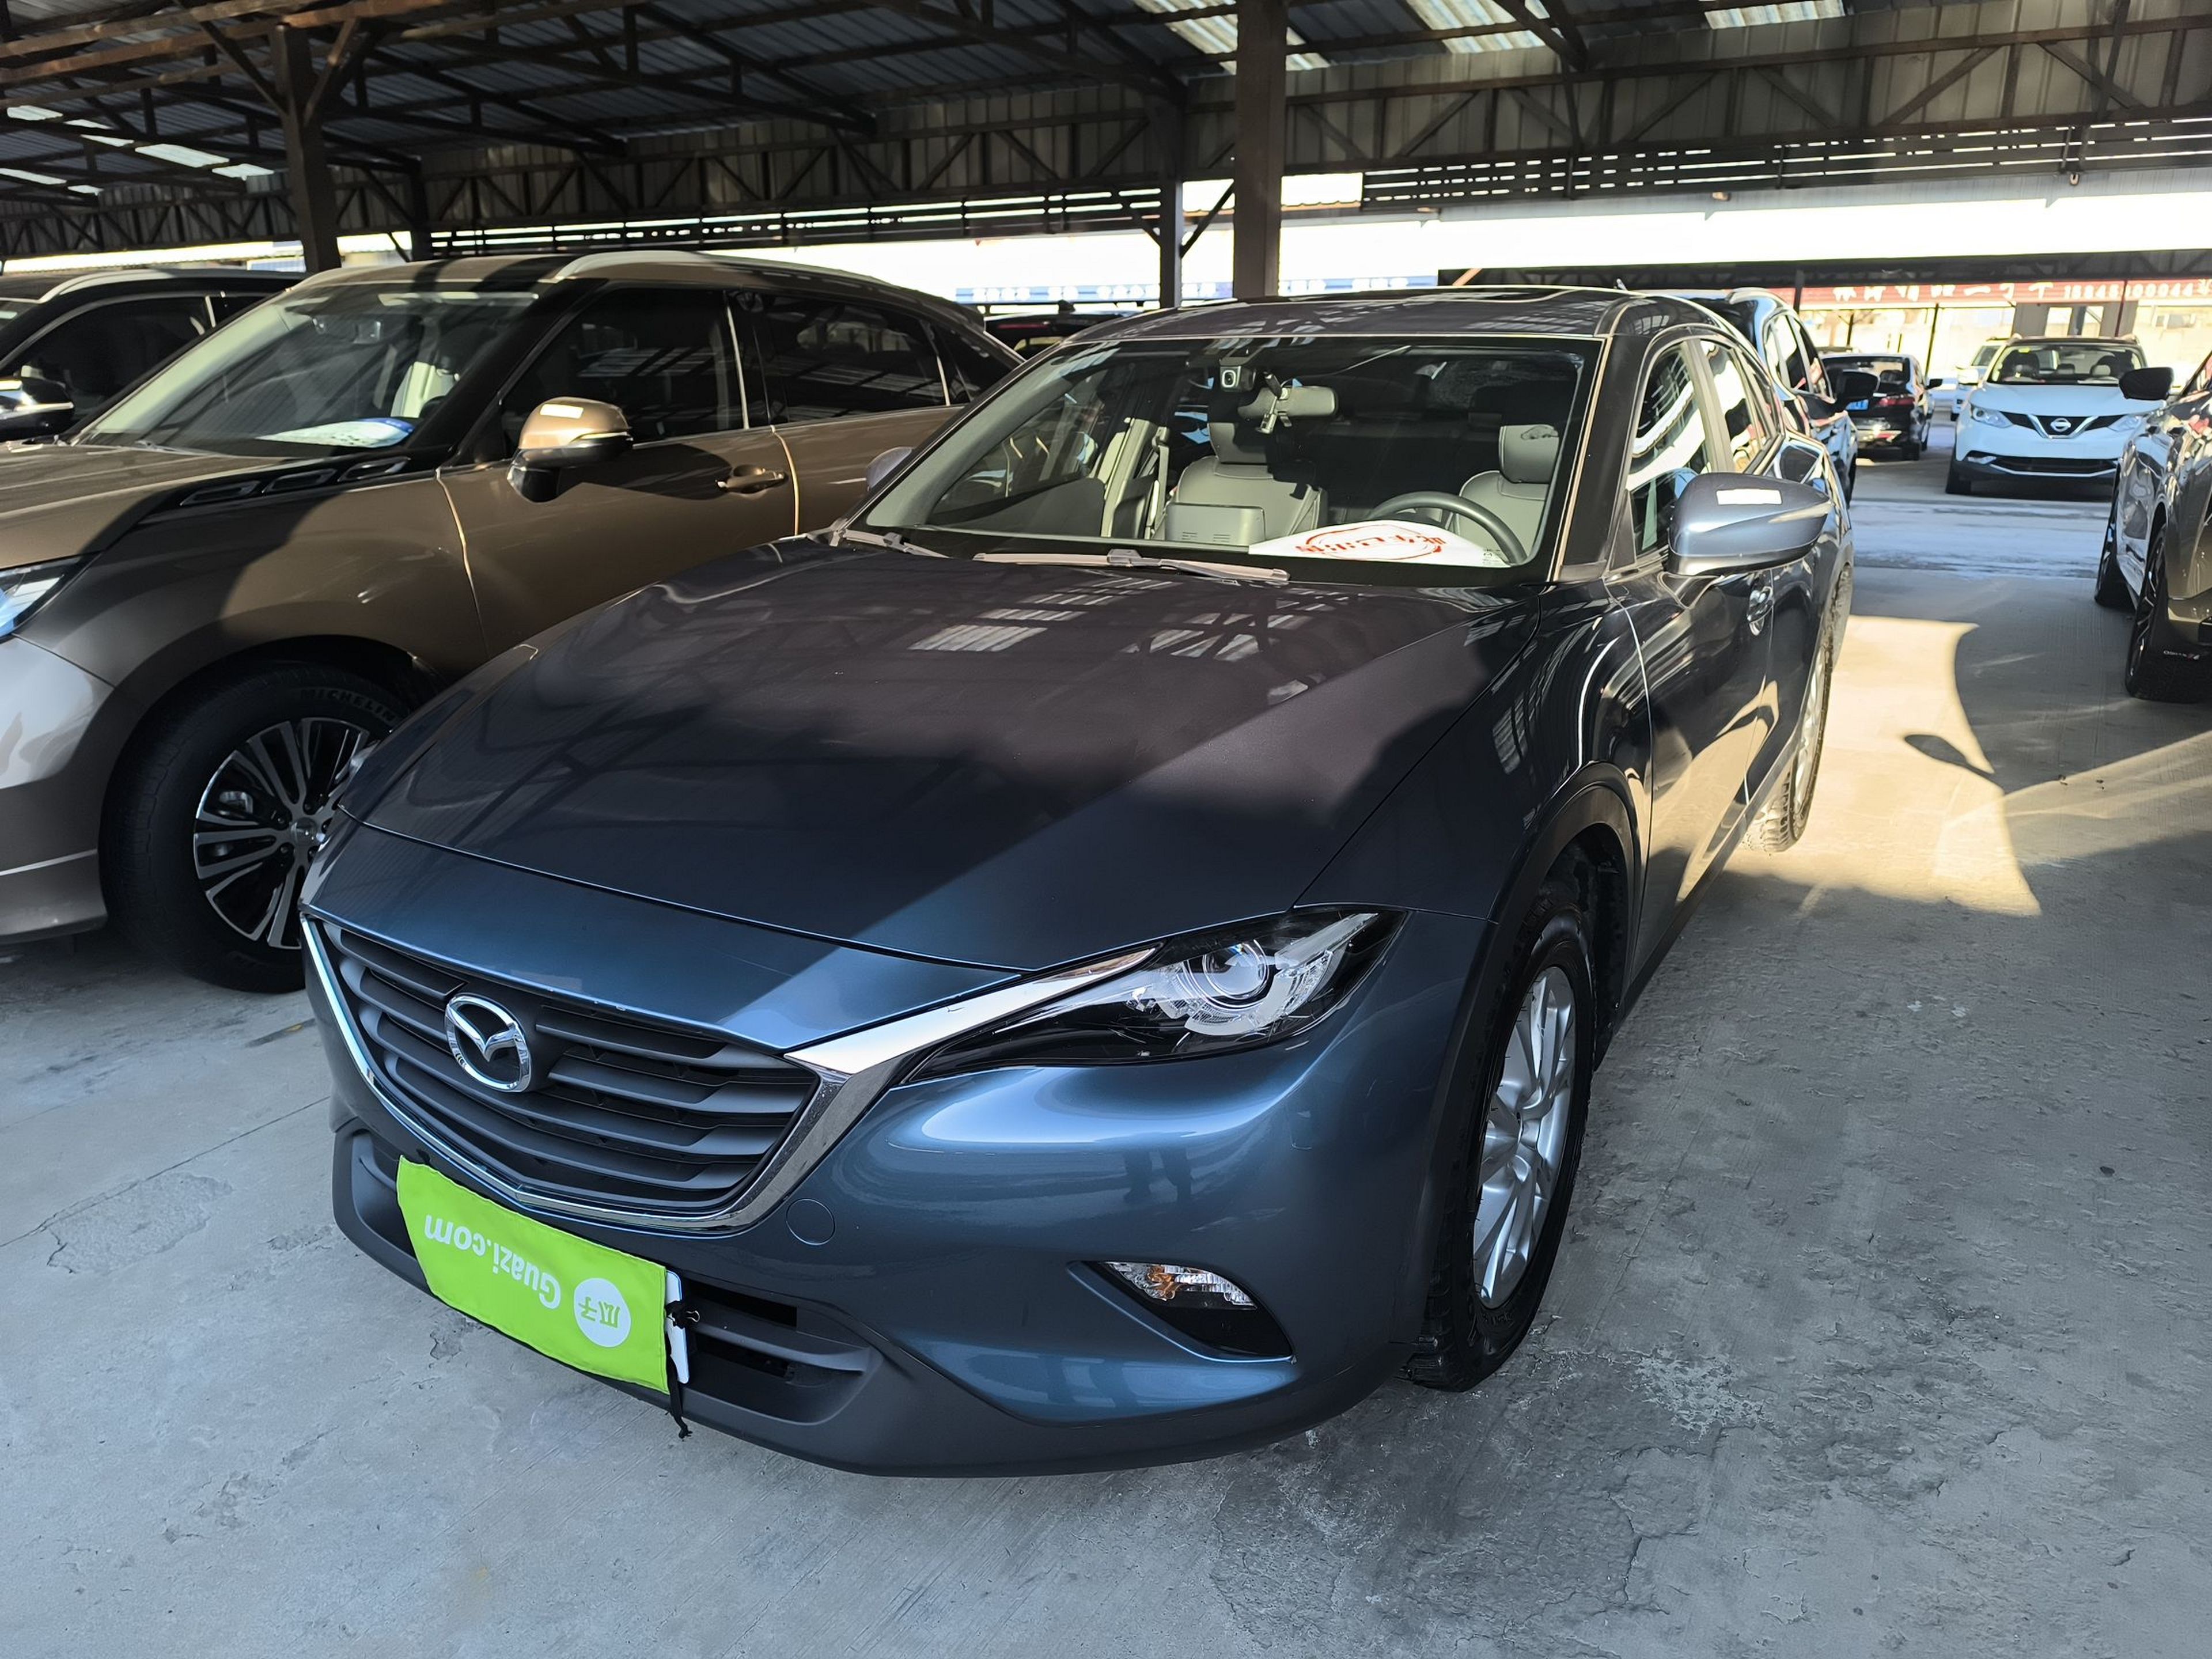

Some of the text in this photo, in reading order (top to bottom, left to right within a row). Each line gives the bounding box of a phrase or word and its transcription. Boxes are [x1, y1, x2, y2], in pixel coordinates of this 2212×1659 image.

[300, 689, 396, 722] MICHELIN
[424, 1214, 561, 1309] Guazi.com
[578, 1296, 621, 1329] 瓜子
